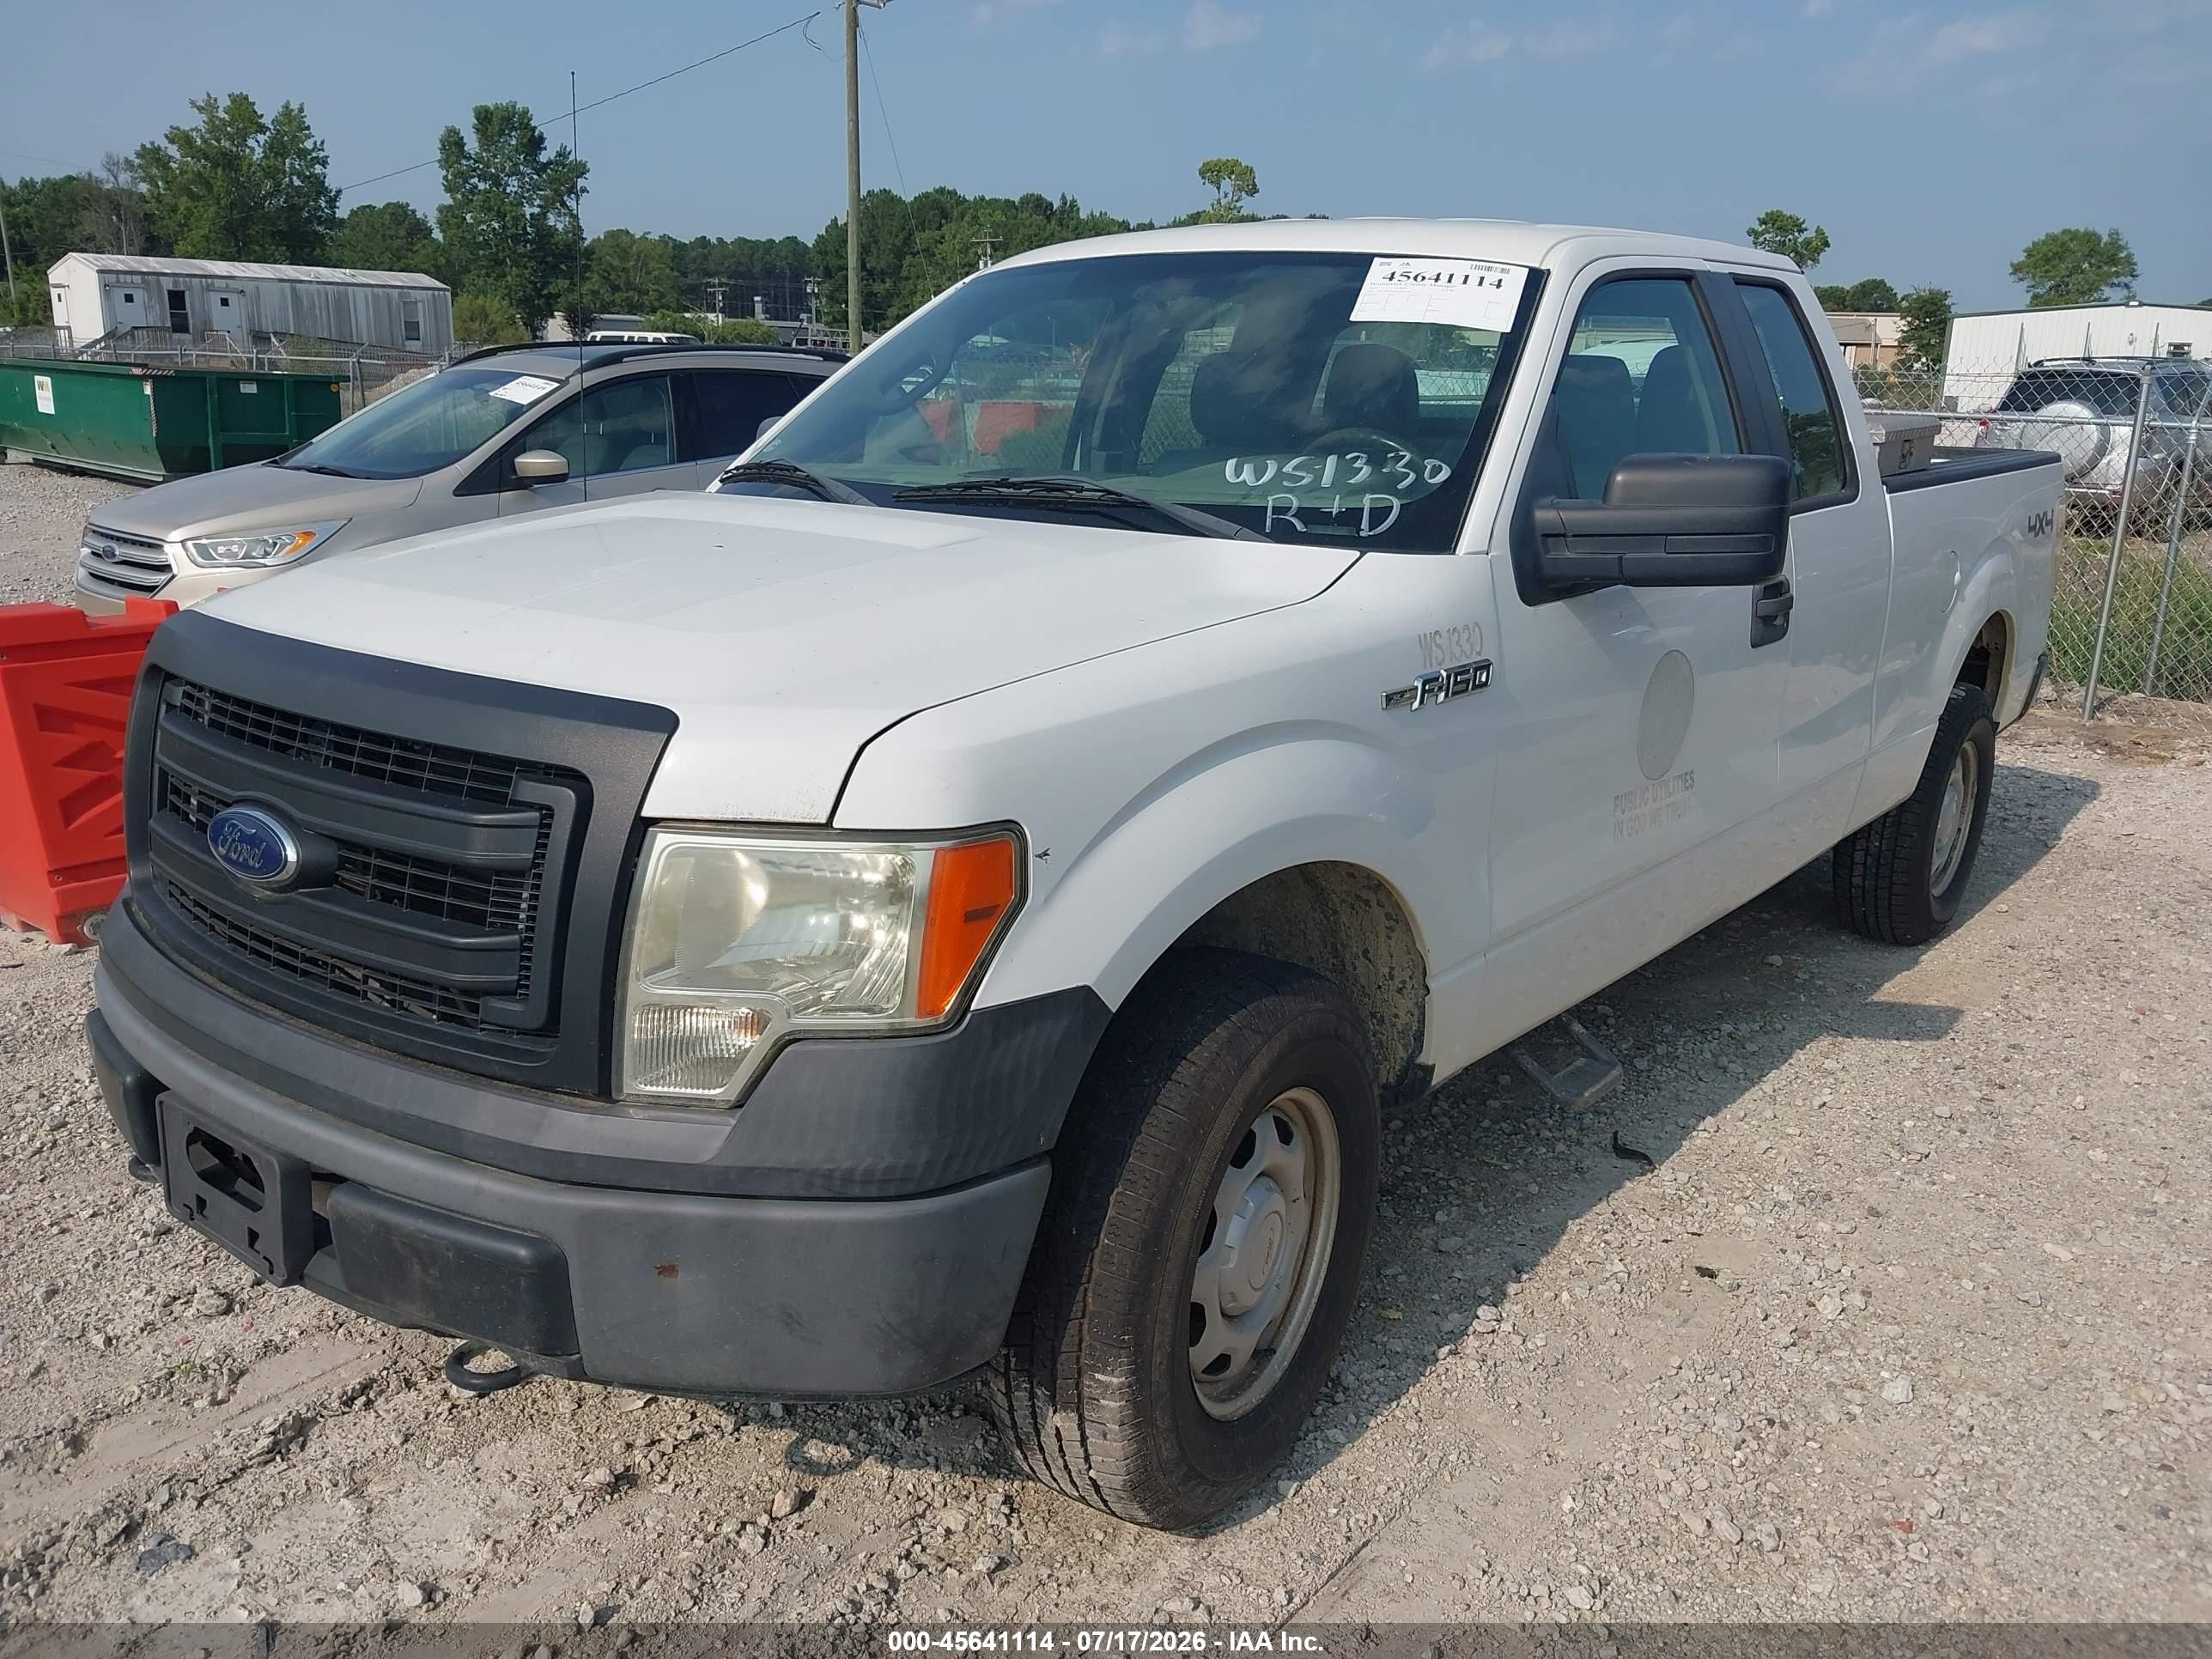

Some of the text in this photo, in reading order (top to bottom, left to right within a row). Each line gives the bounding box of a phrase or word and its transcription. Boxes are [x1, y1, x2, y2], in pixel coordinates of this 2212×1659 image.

[1382, 270, 1504, 289] 45641114
[1613, 769, 1695, 815] PUBLIC UTILITIES
[217, 819, 267, 869] Ford
